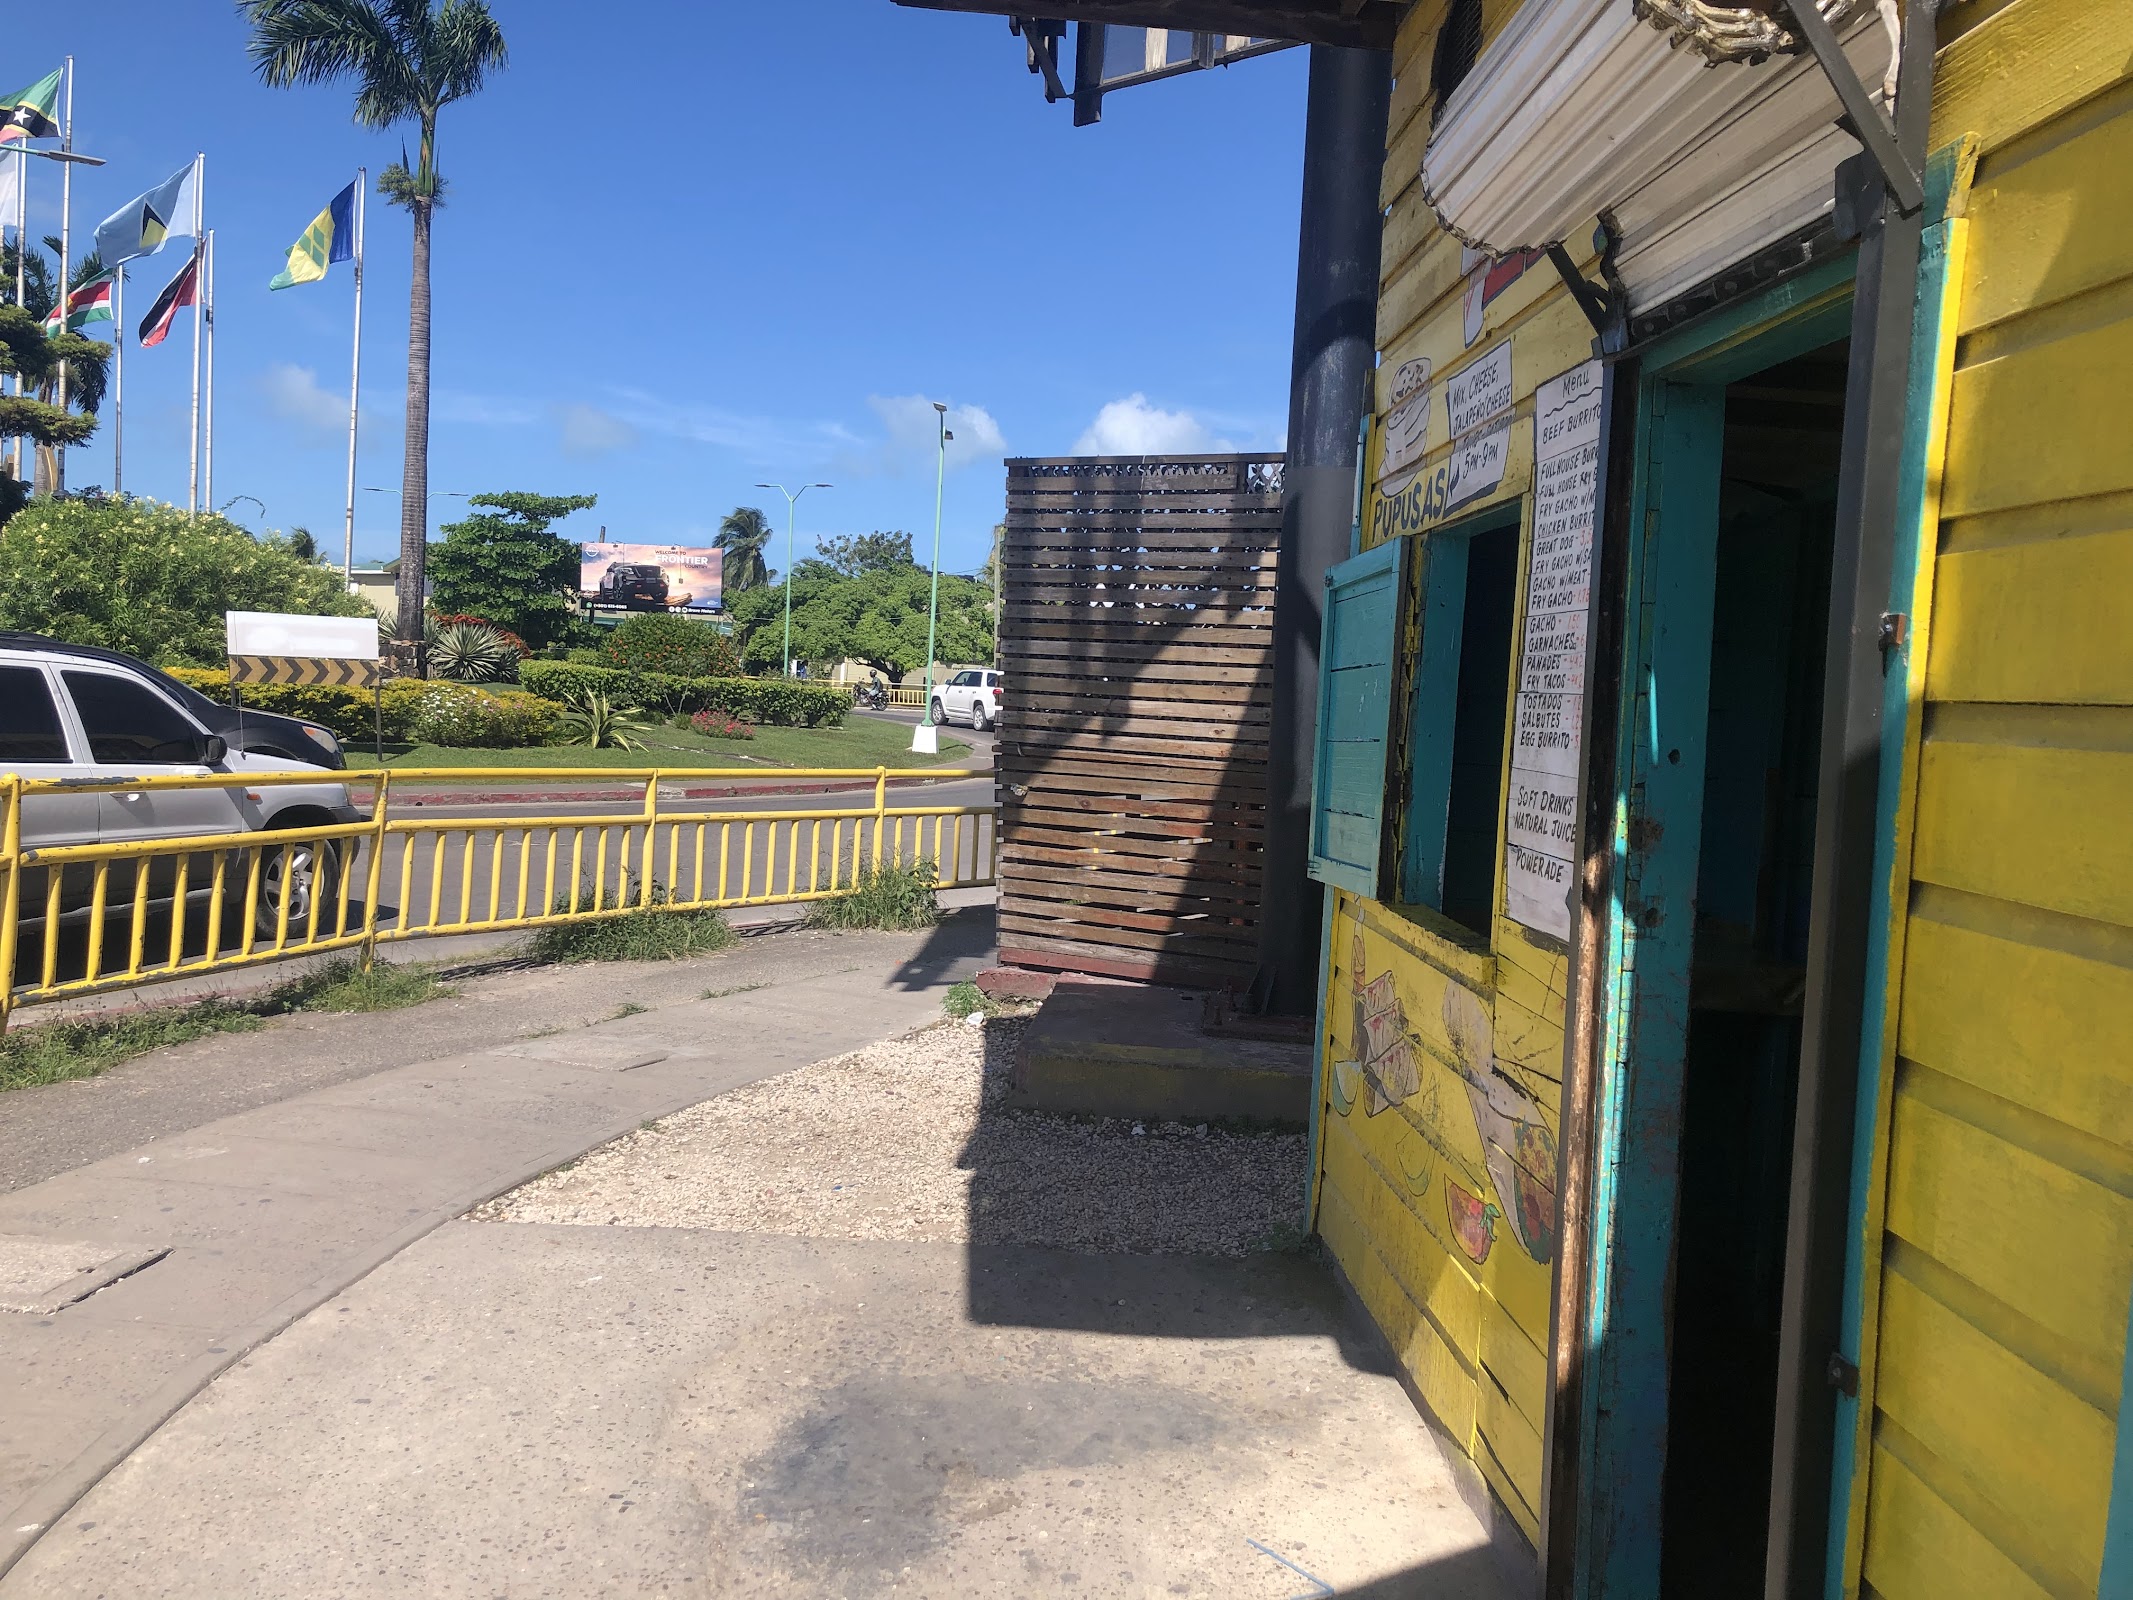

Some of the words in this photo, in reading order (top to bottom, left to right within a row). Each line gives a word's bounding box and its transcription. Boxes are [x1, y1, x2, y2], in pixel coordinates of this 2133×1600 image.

[1562, 369, 1589, 398] Menu
[1542, 420, 1564, 445] BEEF
[1557, 473, 1578, 495] HOUSE
[1372, 467, 1446, 543] PUPUSAS
[1539, 502, 1553, 519] FRY
[1555, 495, 1578, 514] GACHO
[1538, 517, 1568, 538] CHICKEN
[1536, 537, 1559, 557] GREAT
[1559, 535, 1574, 551] DOG
[656, 554, 709, 565] FRONTIER
[1535, 559, 1550, 575] FRY
[1551, 553, 1574, 571] GACHO
[1532, 575, 1556, 593] GACHO
[1531, 594, 1546, 610] FRY
[1547, 590, 1573, 608] GACHO
[1529, 615, 1556, 634] GACHO
[1526, 654, 1561, 671] PANADES
[1526, 674, 1540, 690] FRY
[1543, 673, 1566, 690] TACOS
[1523, 693, 1563, 710] TOSTADOS
[1521, 711, 1561, 728] SALBUTES
[1520, 730, 1535, 747] EGG
[1537, 731, 1570, 749] BURRITO
[1517, 785, 1539, 809] SOFT
[1540, 790, 1574, 816] DRINKS
[1514, 811, 1548, 835] NATURAL
[1515, 848, 1564, 883] POWERADE
